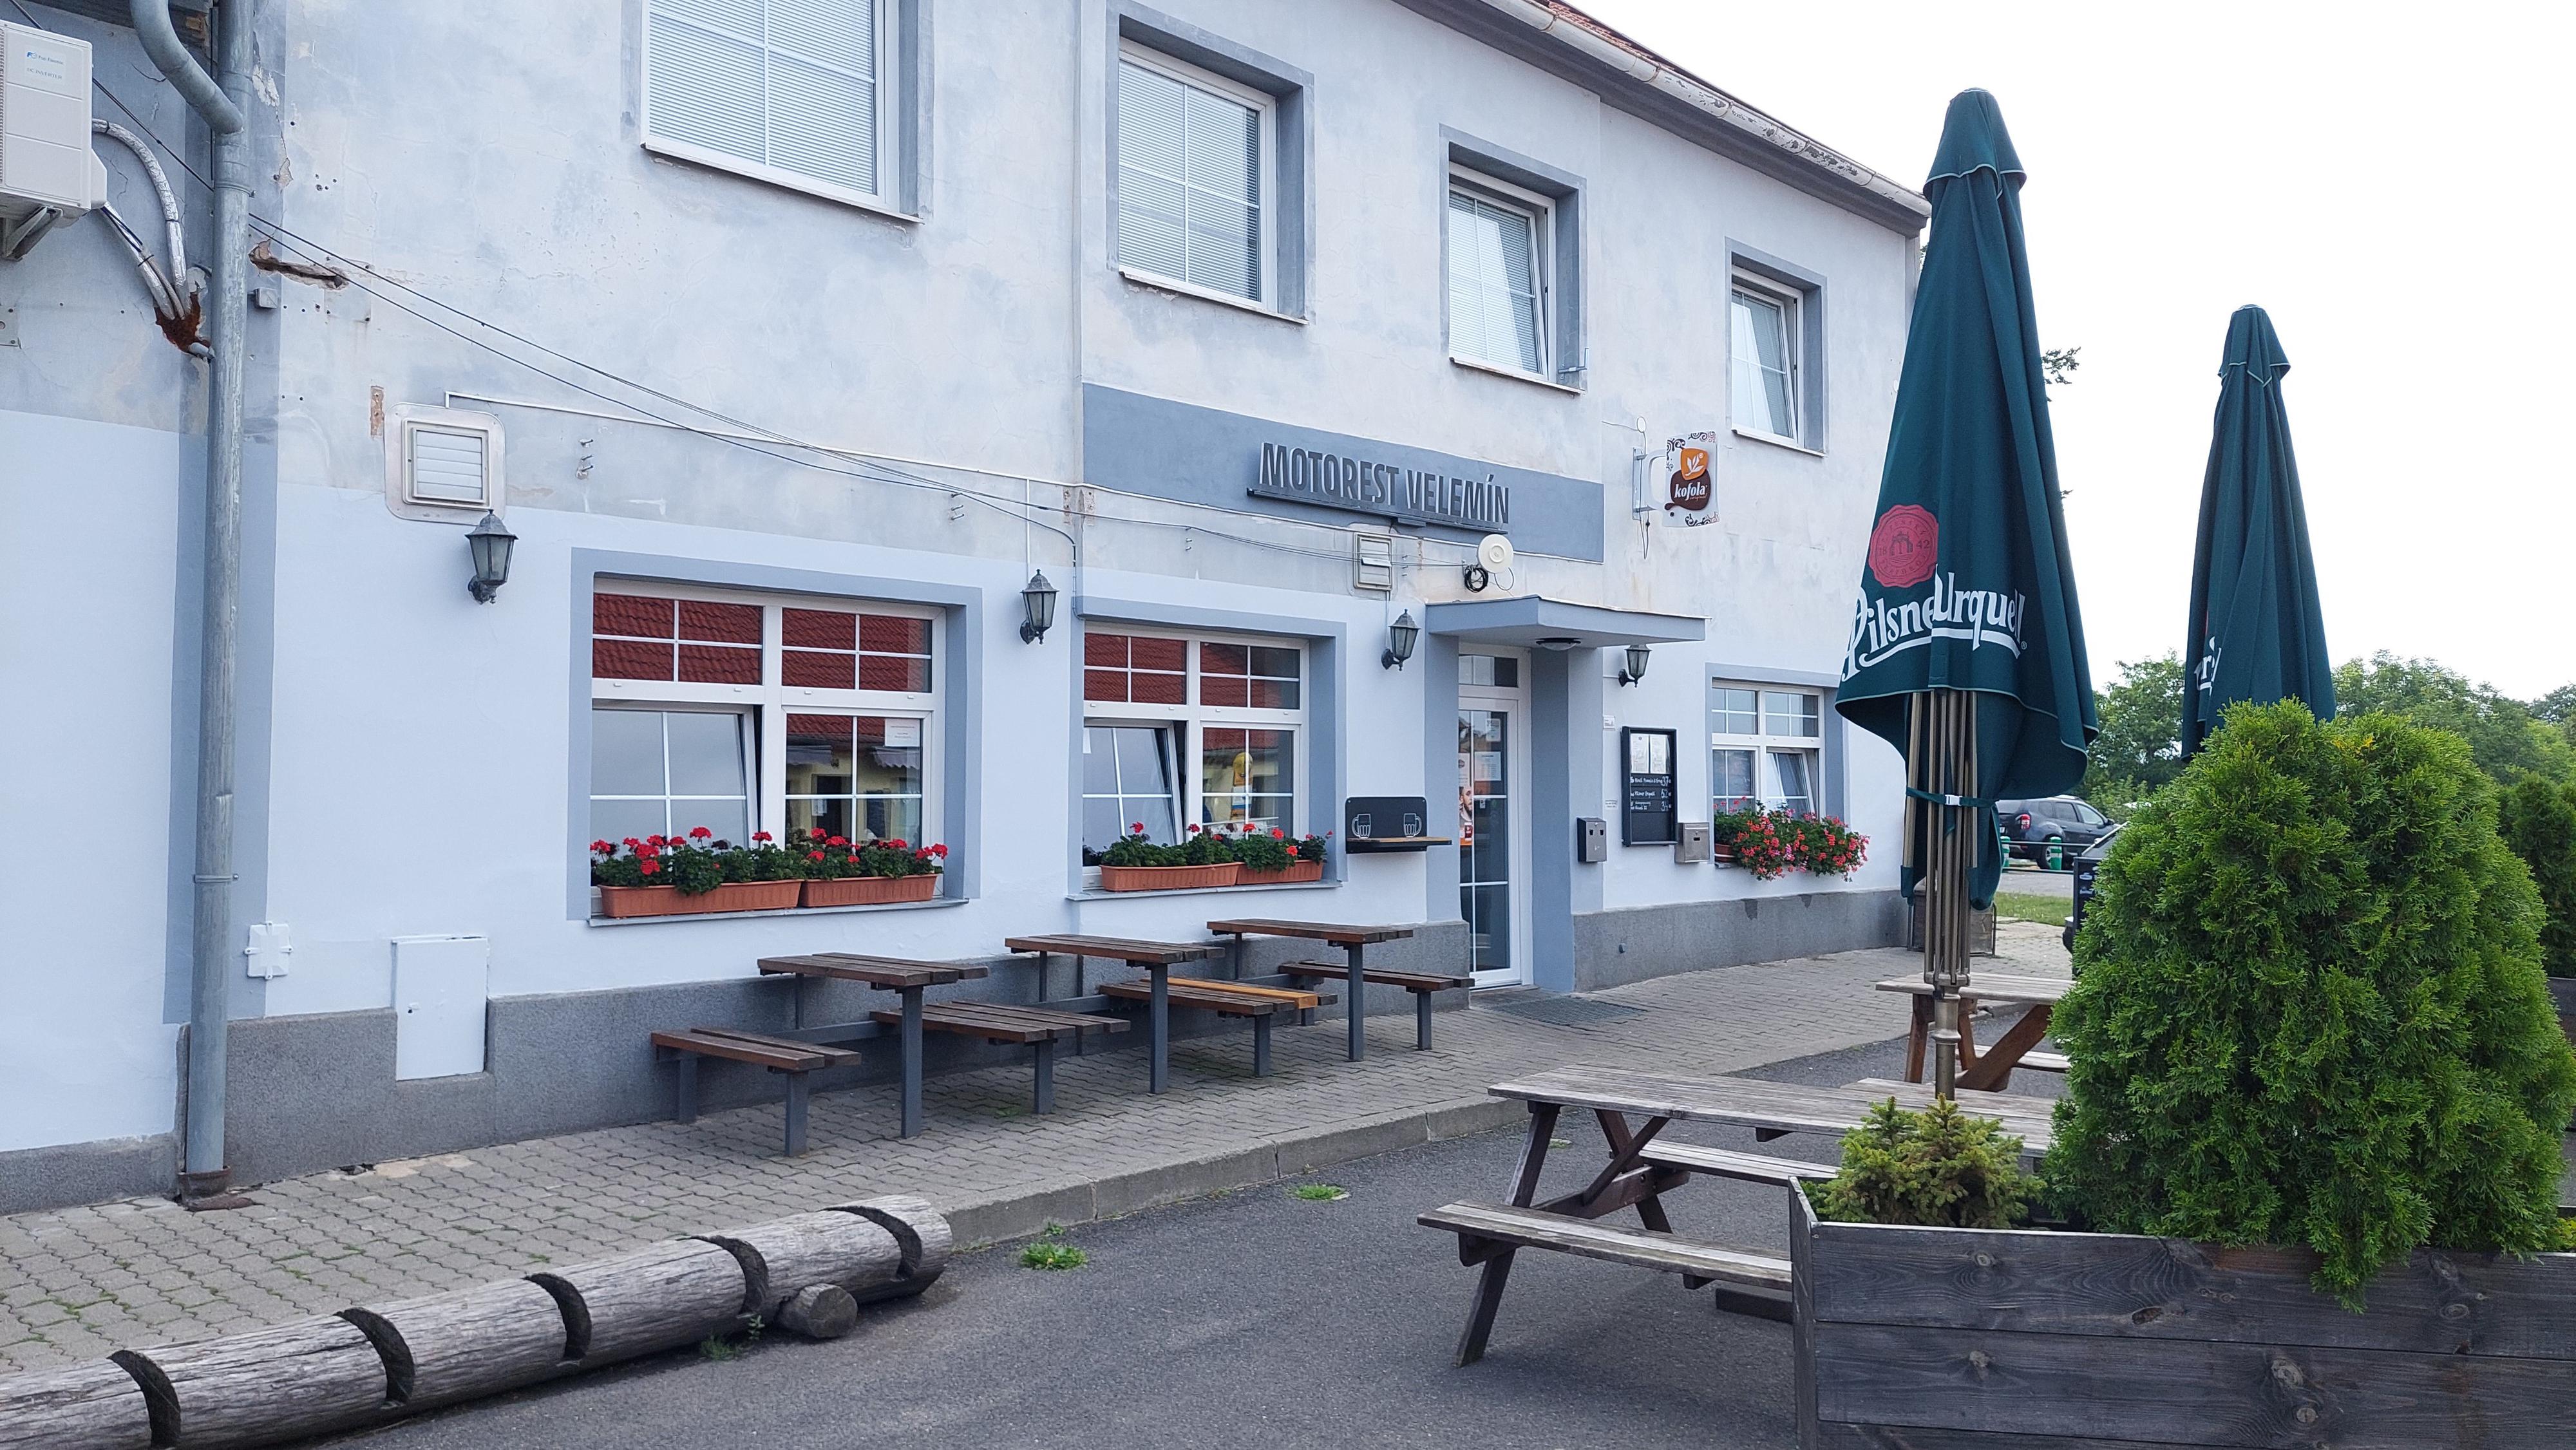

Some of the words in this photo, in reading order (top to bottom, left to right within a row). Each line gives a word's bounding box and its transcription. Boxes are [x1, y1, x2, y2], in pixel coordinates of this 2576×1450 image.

[1259, 442, 1399, 506] MOTOREST
[1405, 469, 1510, 524] VELEMÍN
[1674, 482, 1706, 501] kofola
[1917, 540, 1930, 549] 42
[1842, 587, 1935, 683] Pilsne
[1662, 776, 1669, 787] 37
